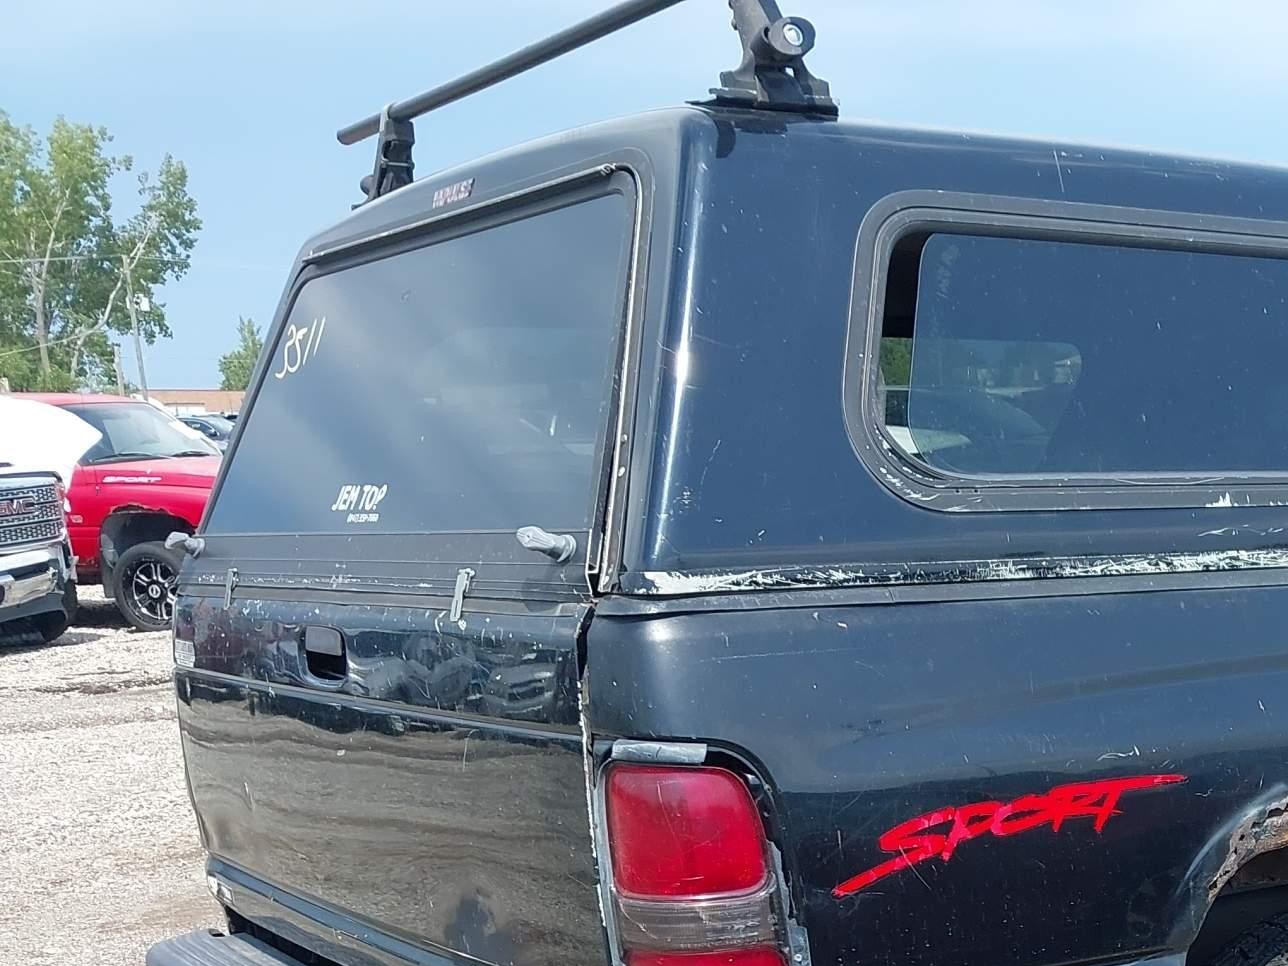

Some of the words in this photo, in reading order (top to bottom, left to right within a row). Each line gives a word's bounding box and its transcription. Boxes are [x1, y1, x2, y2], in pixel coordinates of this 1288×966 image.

[274, 316, 326, 379] 3511
[331, 484, 361, 511] JEM
[830, 774, 1191, 900] SPORT
